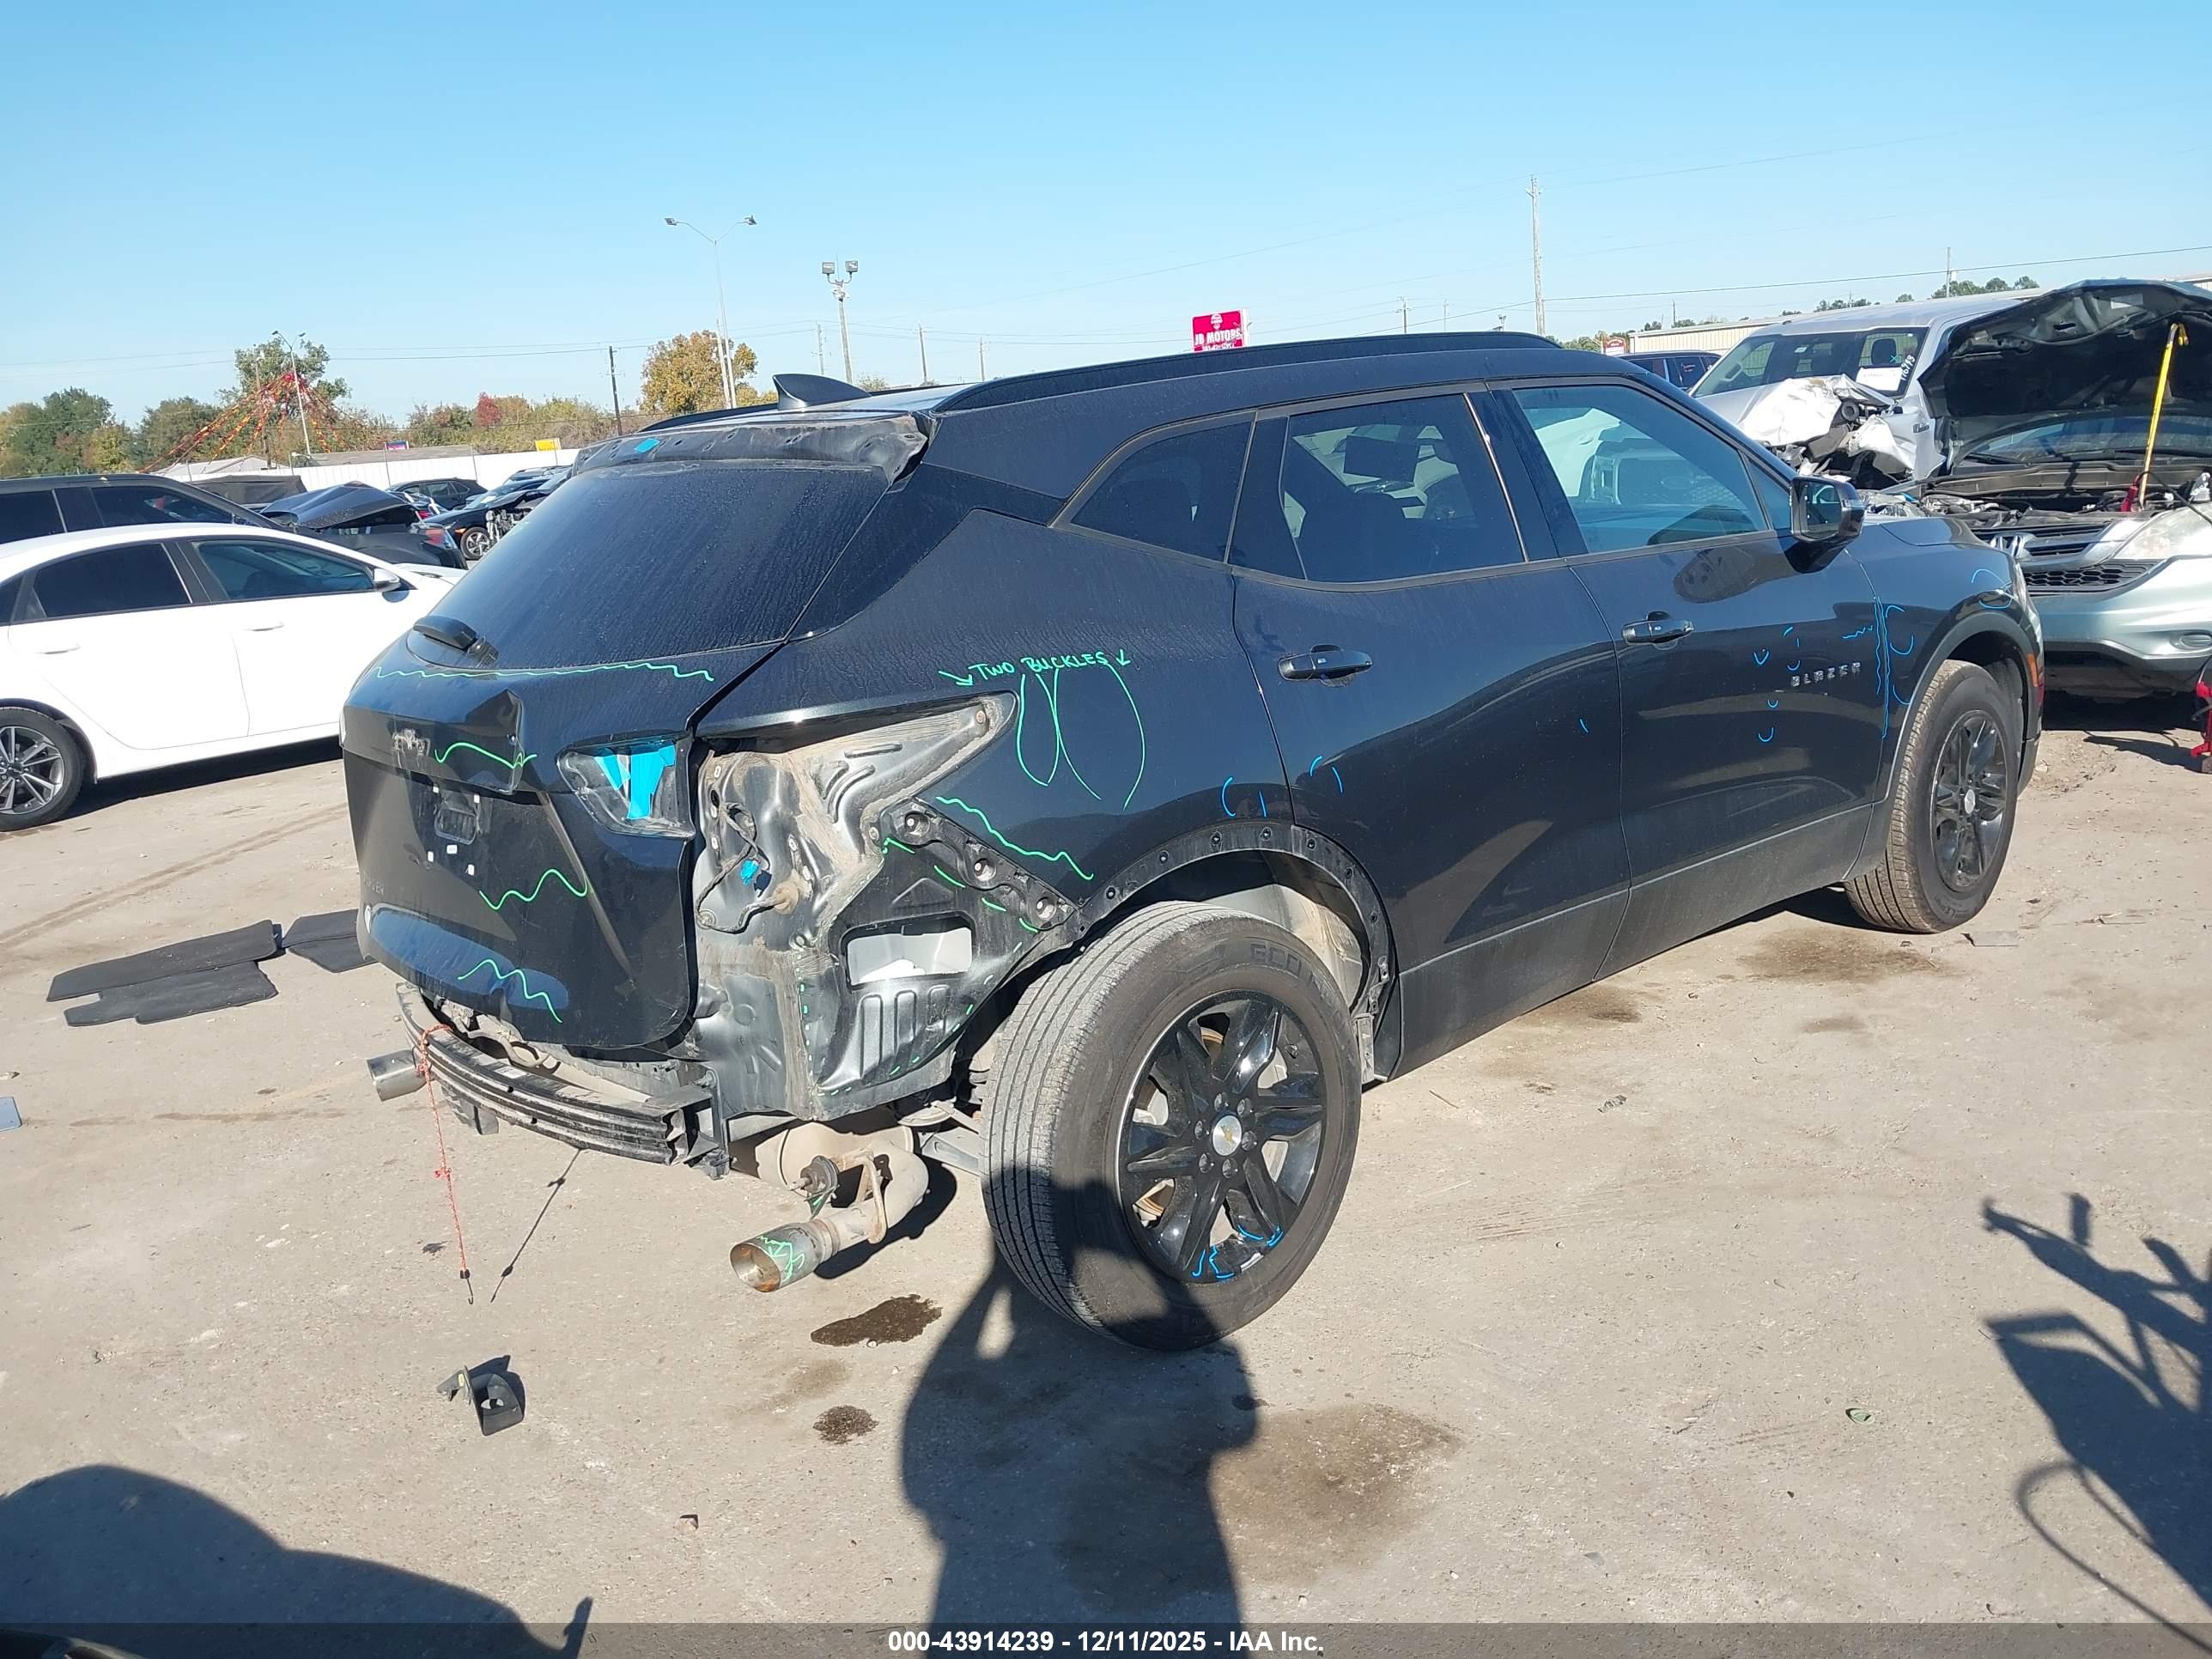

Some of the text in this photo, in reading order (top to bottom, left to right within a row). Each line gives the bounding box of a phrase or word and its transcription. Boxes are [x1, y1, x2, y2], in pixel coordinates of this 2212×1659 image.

[1206, 328, 1242, 343] MOTORS
[968, 651, 1109, 680] TWO BUCKLES
[1791, 661, 1862, 688] BLAZER
